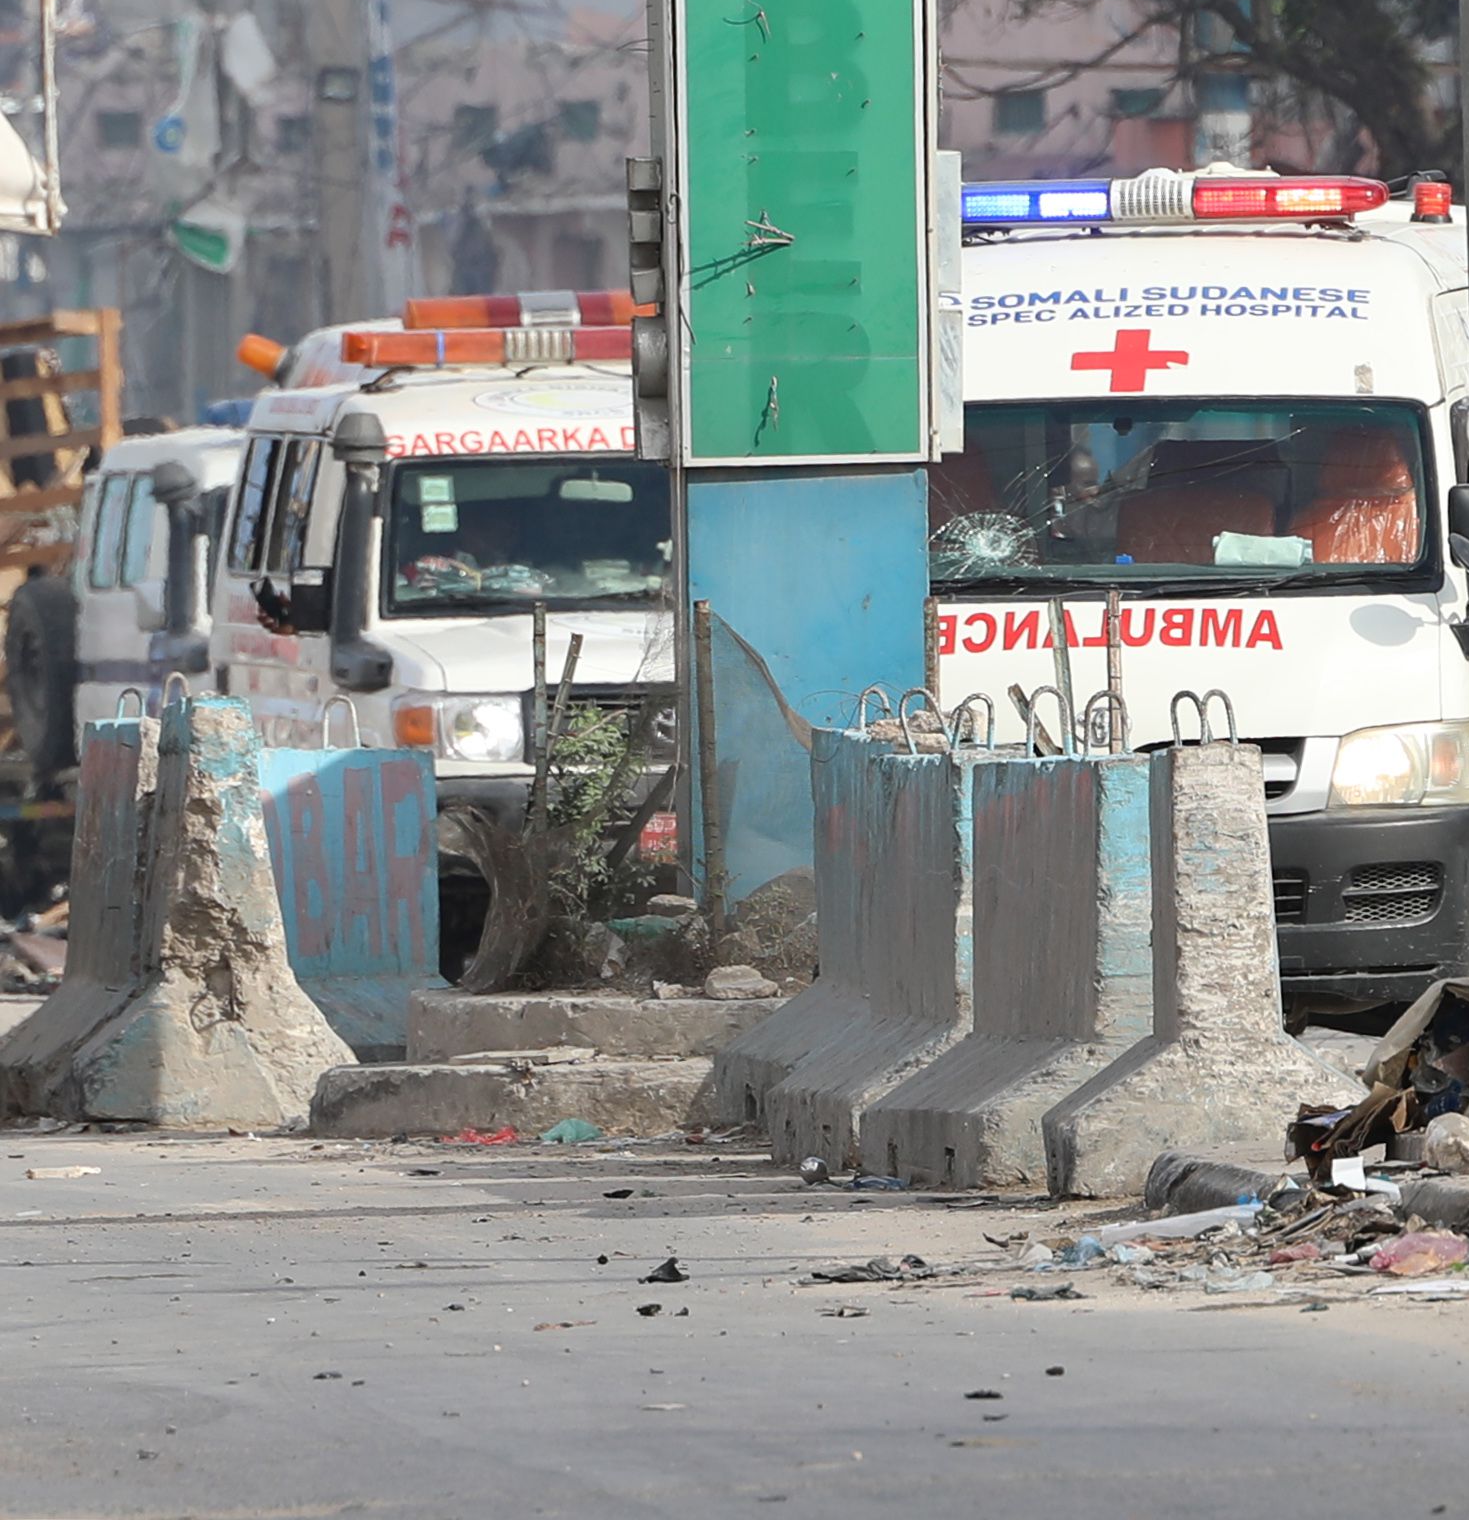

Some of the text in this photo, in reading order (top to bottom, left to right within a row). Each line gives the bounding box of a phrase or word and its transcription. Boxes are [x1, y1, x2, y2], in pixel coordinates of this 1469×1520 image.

[970, 285, 1371, 310] SOMALI SUDANESE
[1200, 303, 1369, 320] HOSPITAL
[384, 426, 621, 457] GARGAARKA
[261, 760, 429, 965] BAR
